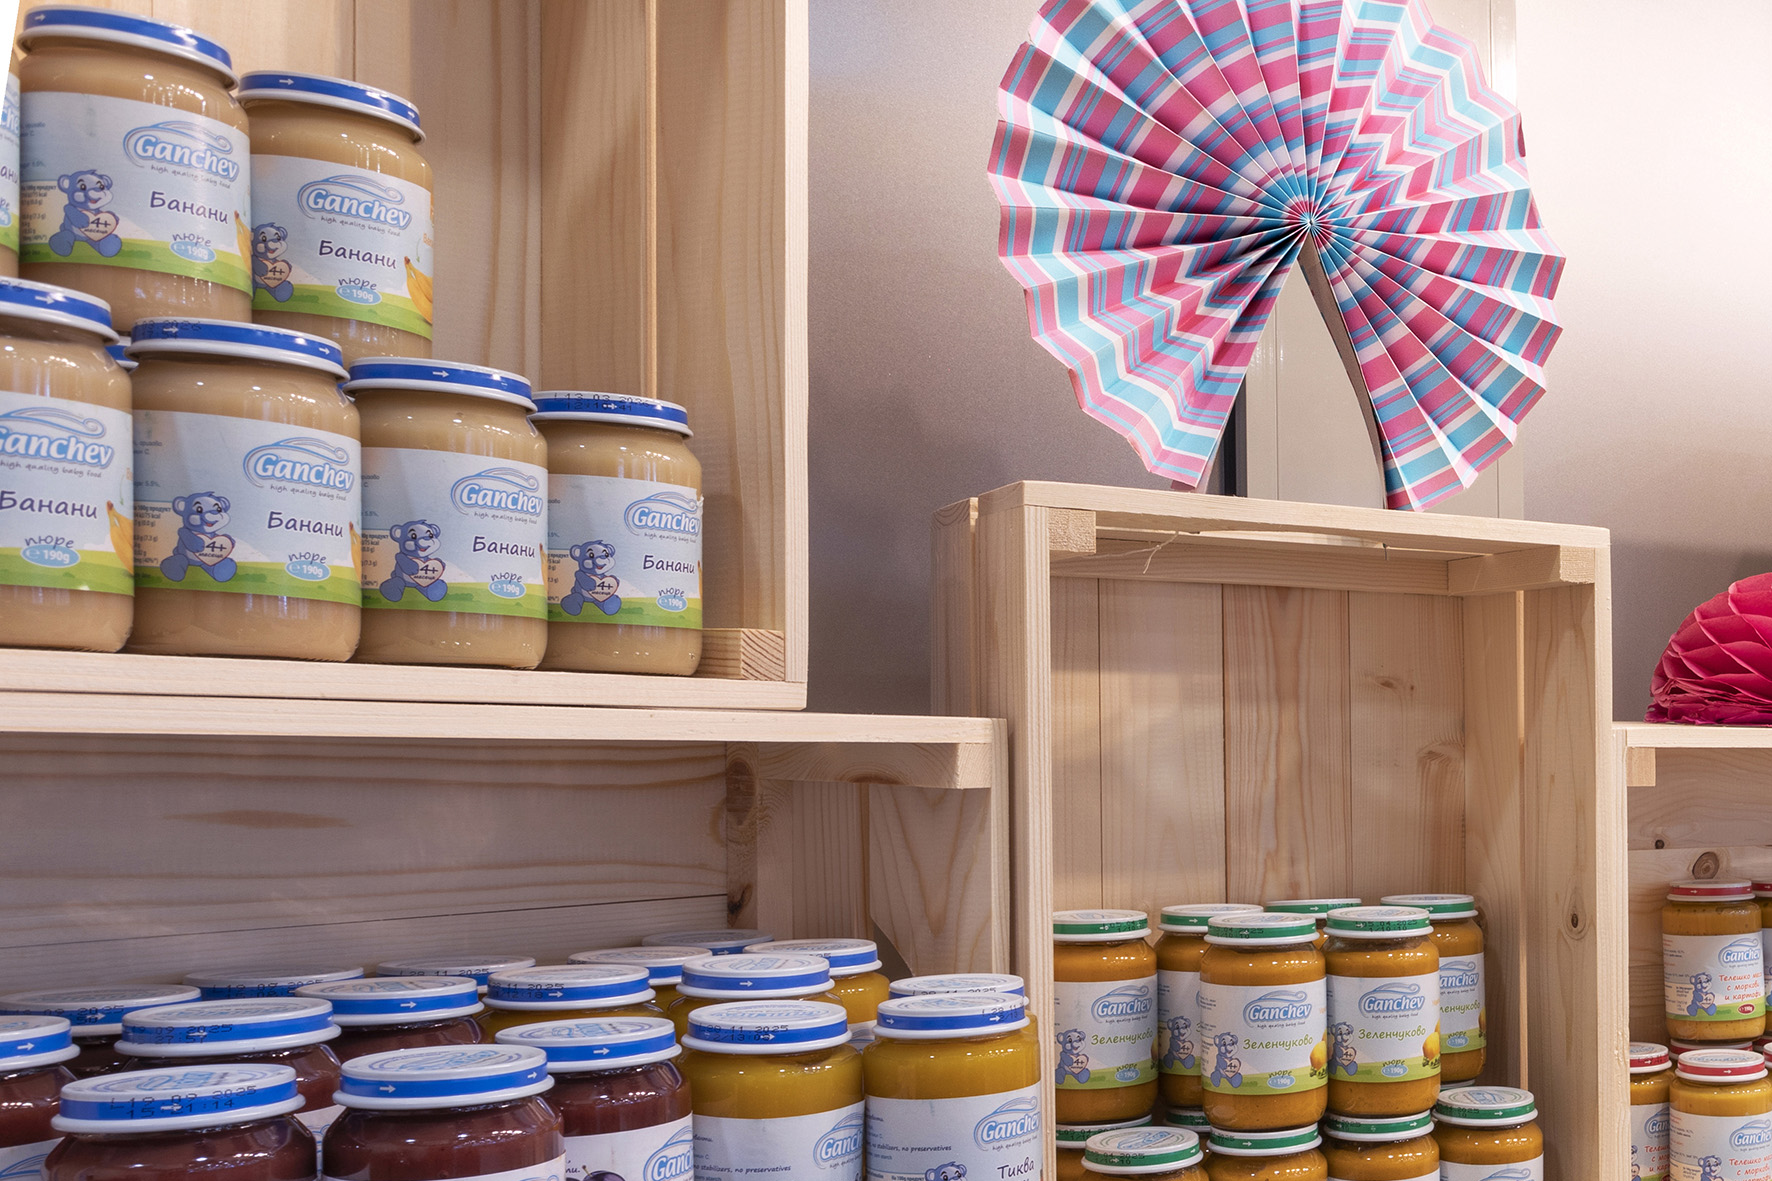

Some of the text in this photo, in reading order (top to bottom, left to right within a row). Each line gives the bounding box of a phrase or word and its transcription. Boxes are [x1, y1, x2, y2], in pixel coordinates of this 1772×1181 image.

[134, 135, 239, 182] Ganchev
[150, 191, 228, 224] Банани
[307, 188, 411, 229] Ganchev
[90, 217, 111, 228] 4+
[172, 232, 211, 247] пюре
[318, 240, 396, 269] Банани
[269, 265, 286, 276] 4+
[338, 277, 377, 290] пюре
[62, 466, 84, 479] baby
[254, 453, 355, 493] Ganchev
[0, 489, 98, 519] Банани
[460, 483, 543, 516] Ganchev
[267, 511, 344, 538] Банани
[25, 535, 74, 549] пюре
[205, 541, 227, 552] 4+
[473, 536, 535, 558] Банани
[289, 552, 327, 564] пюре
[643, 554, 695, 575] Банани
[419, 564, 438, 574] 4+
[491, 571, 522, 584] пюре
[596, 580, 613, 590] 4+
[658, 588, 685, 598] пюре
[1249, 1002, 1312, 1022] Ganchev
[1364, 994, 1425, 1013] Ganchev
[1358, 1025, 1426, 1041] Зеленчуково
[1242, 1034, 1314, 1051] Зеленчуково
[997, 1156, 1035, 1180] Тиква
